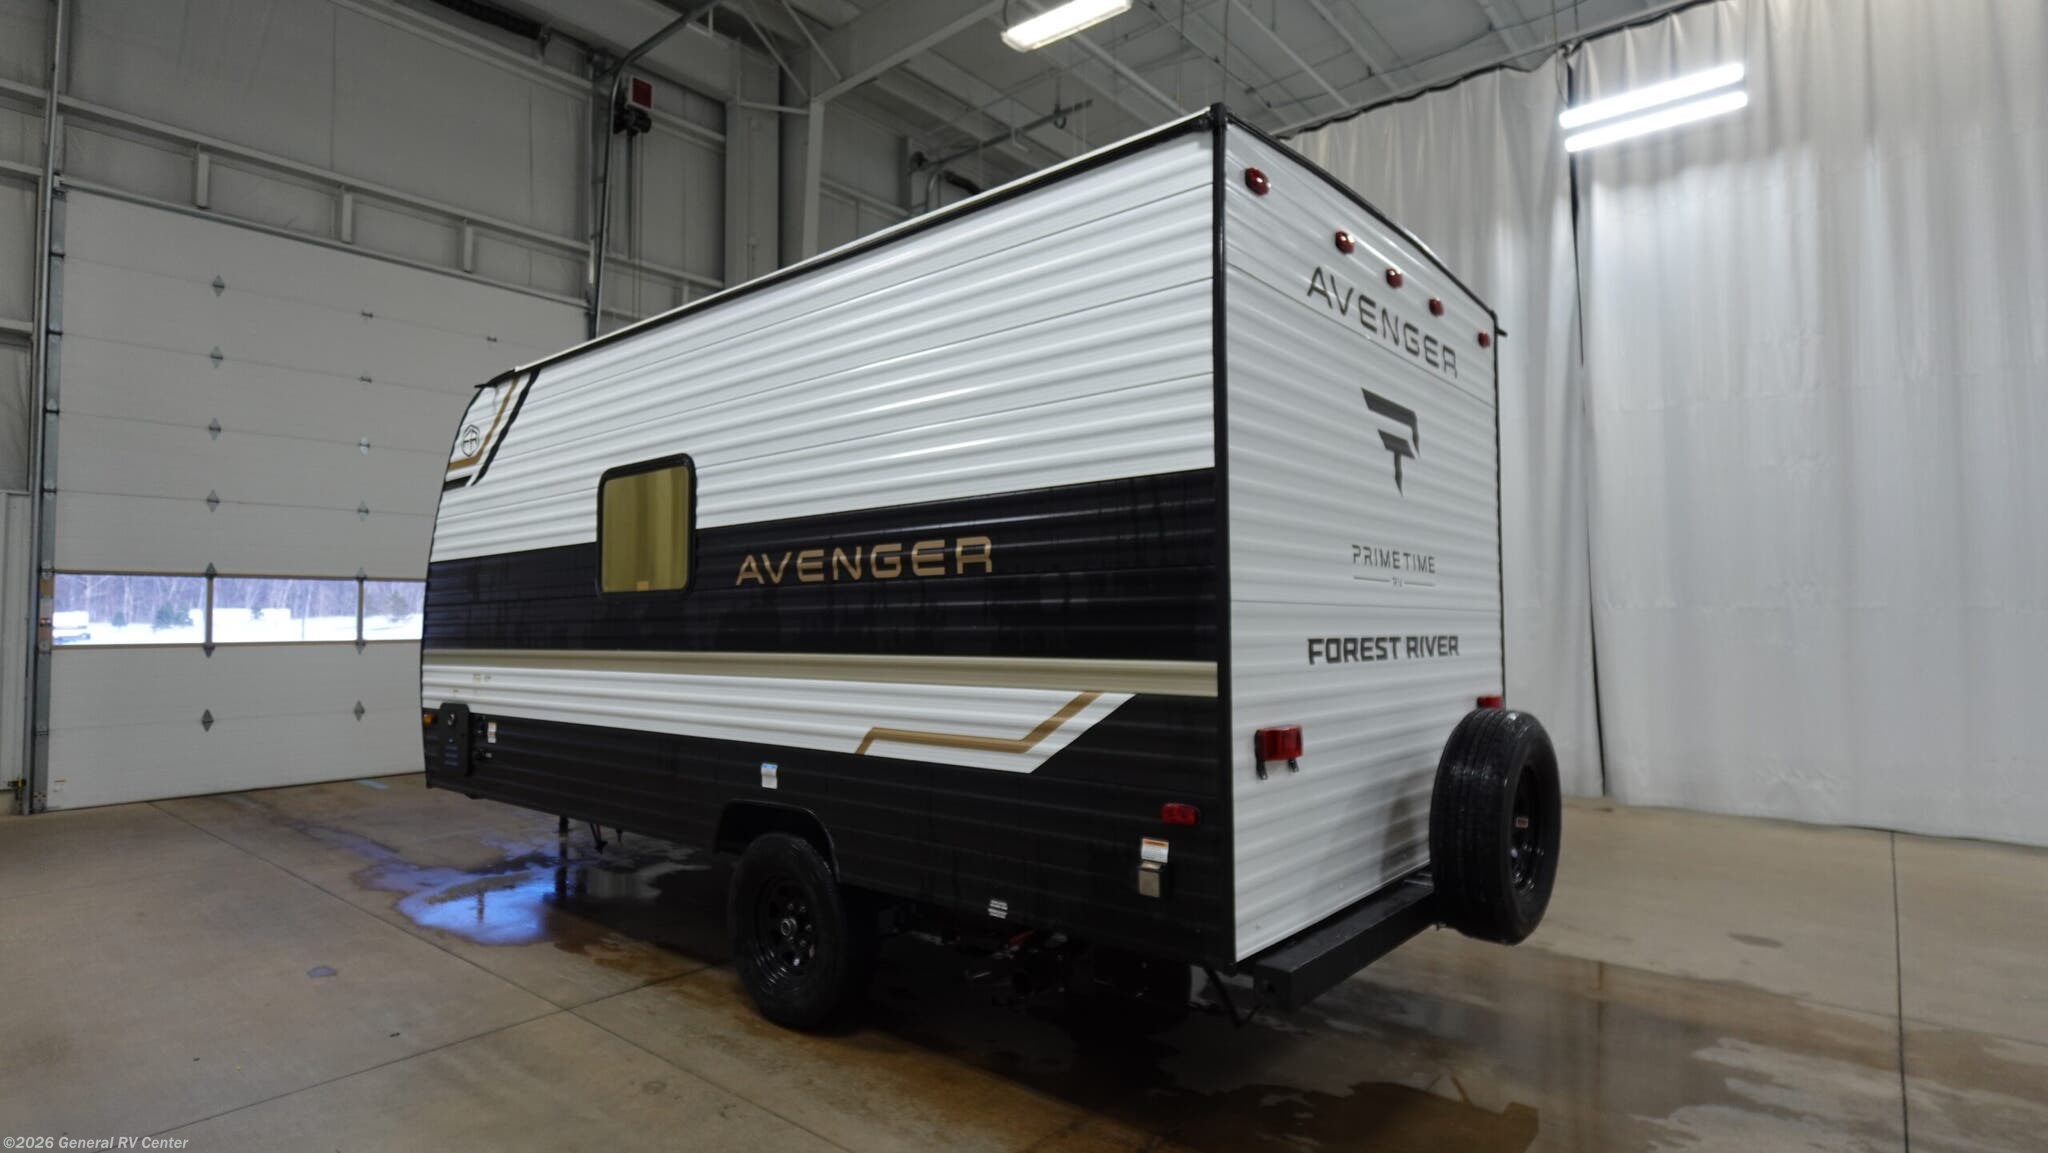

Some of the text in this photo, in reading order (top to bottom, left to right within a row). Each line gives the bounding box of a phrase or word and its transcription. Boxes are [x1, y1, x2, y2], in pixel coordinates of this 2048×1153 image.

[1307, 266, 1458, 379] AVENGER
[736, 535, 992, 586] AVENGER
[1307, 635, 1460, 665] FOREST RIVER
